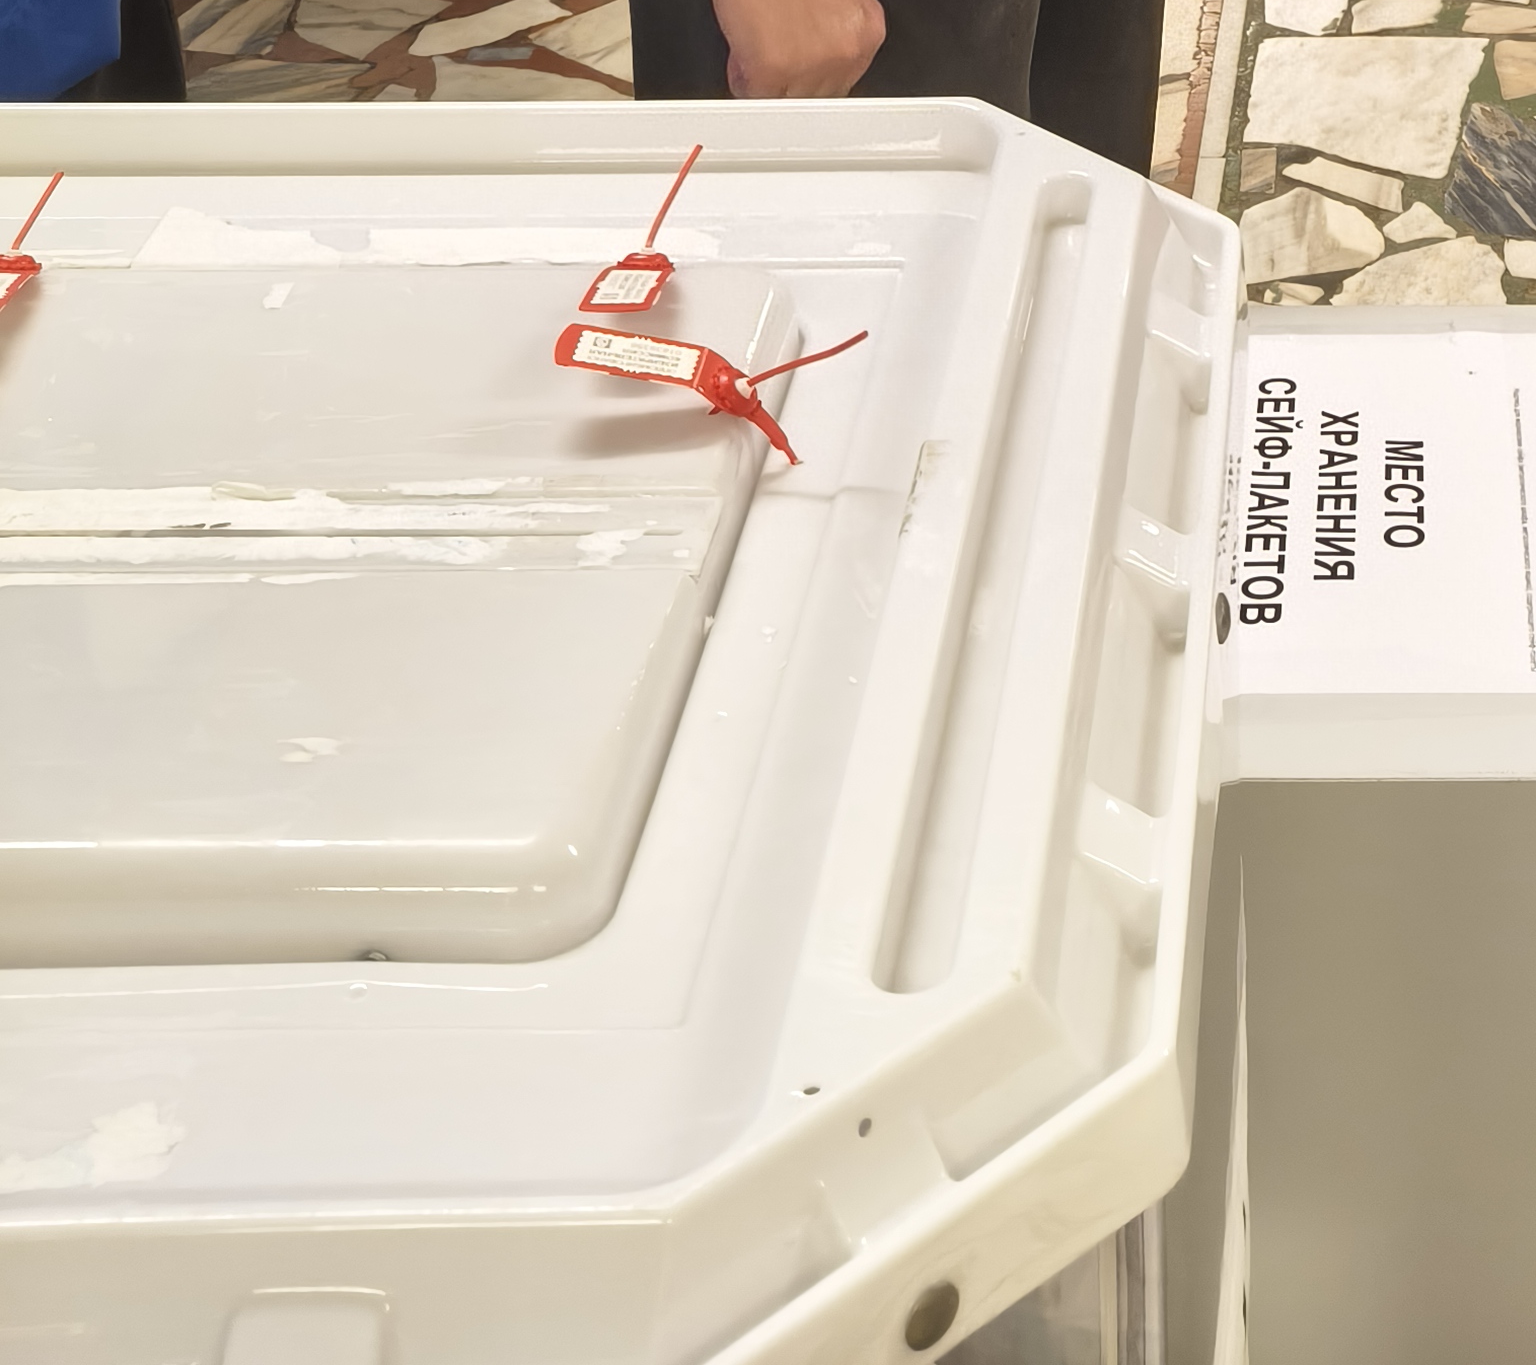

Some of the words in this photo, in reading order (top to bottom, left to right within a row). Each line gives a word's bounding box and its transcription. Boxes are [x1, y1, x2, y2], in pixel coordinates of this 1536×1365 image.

[1239, 377, 1304, 625] СЕЙФ-ПАКЕТОВ
[1313, 411, 1360, 581] ХРАНЕНИЯ
[1383, 440, 1426, 548] МЕСТО
